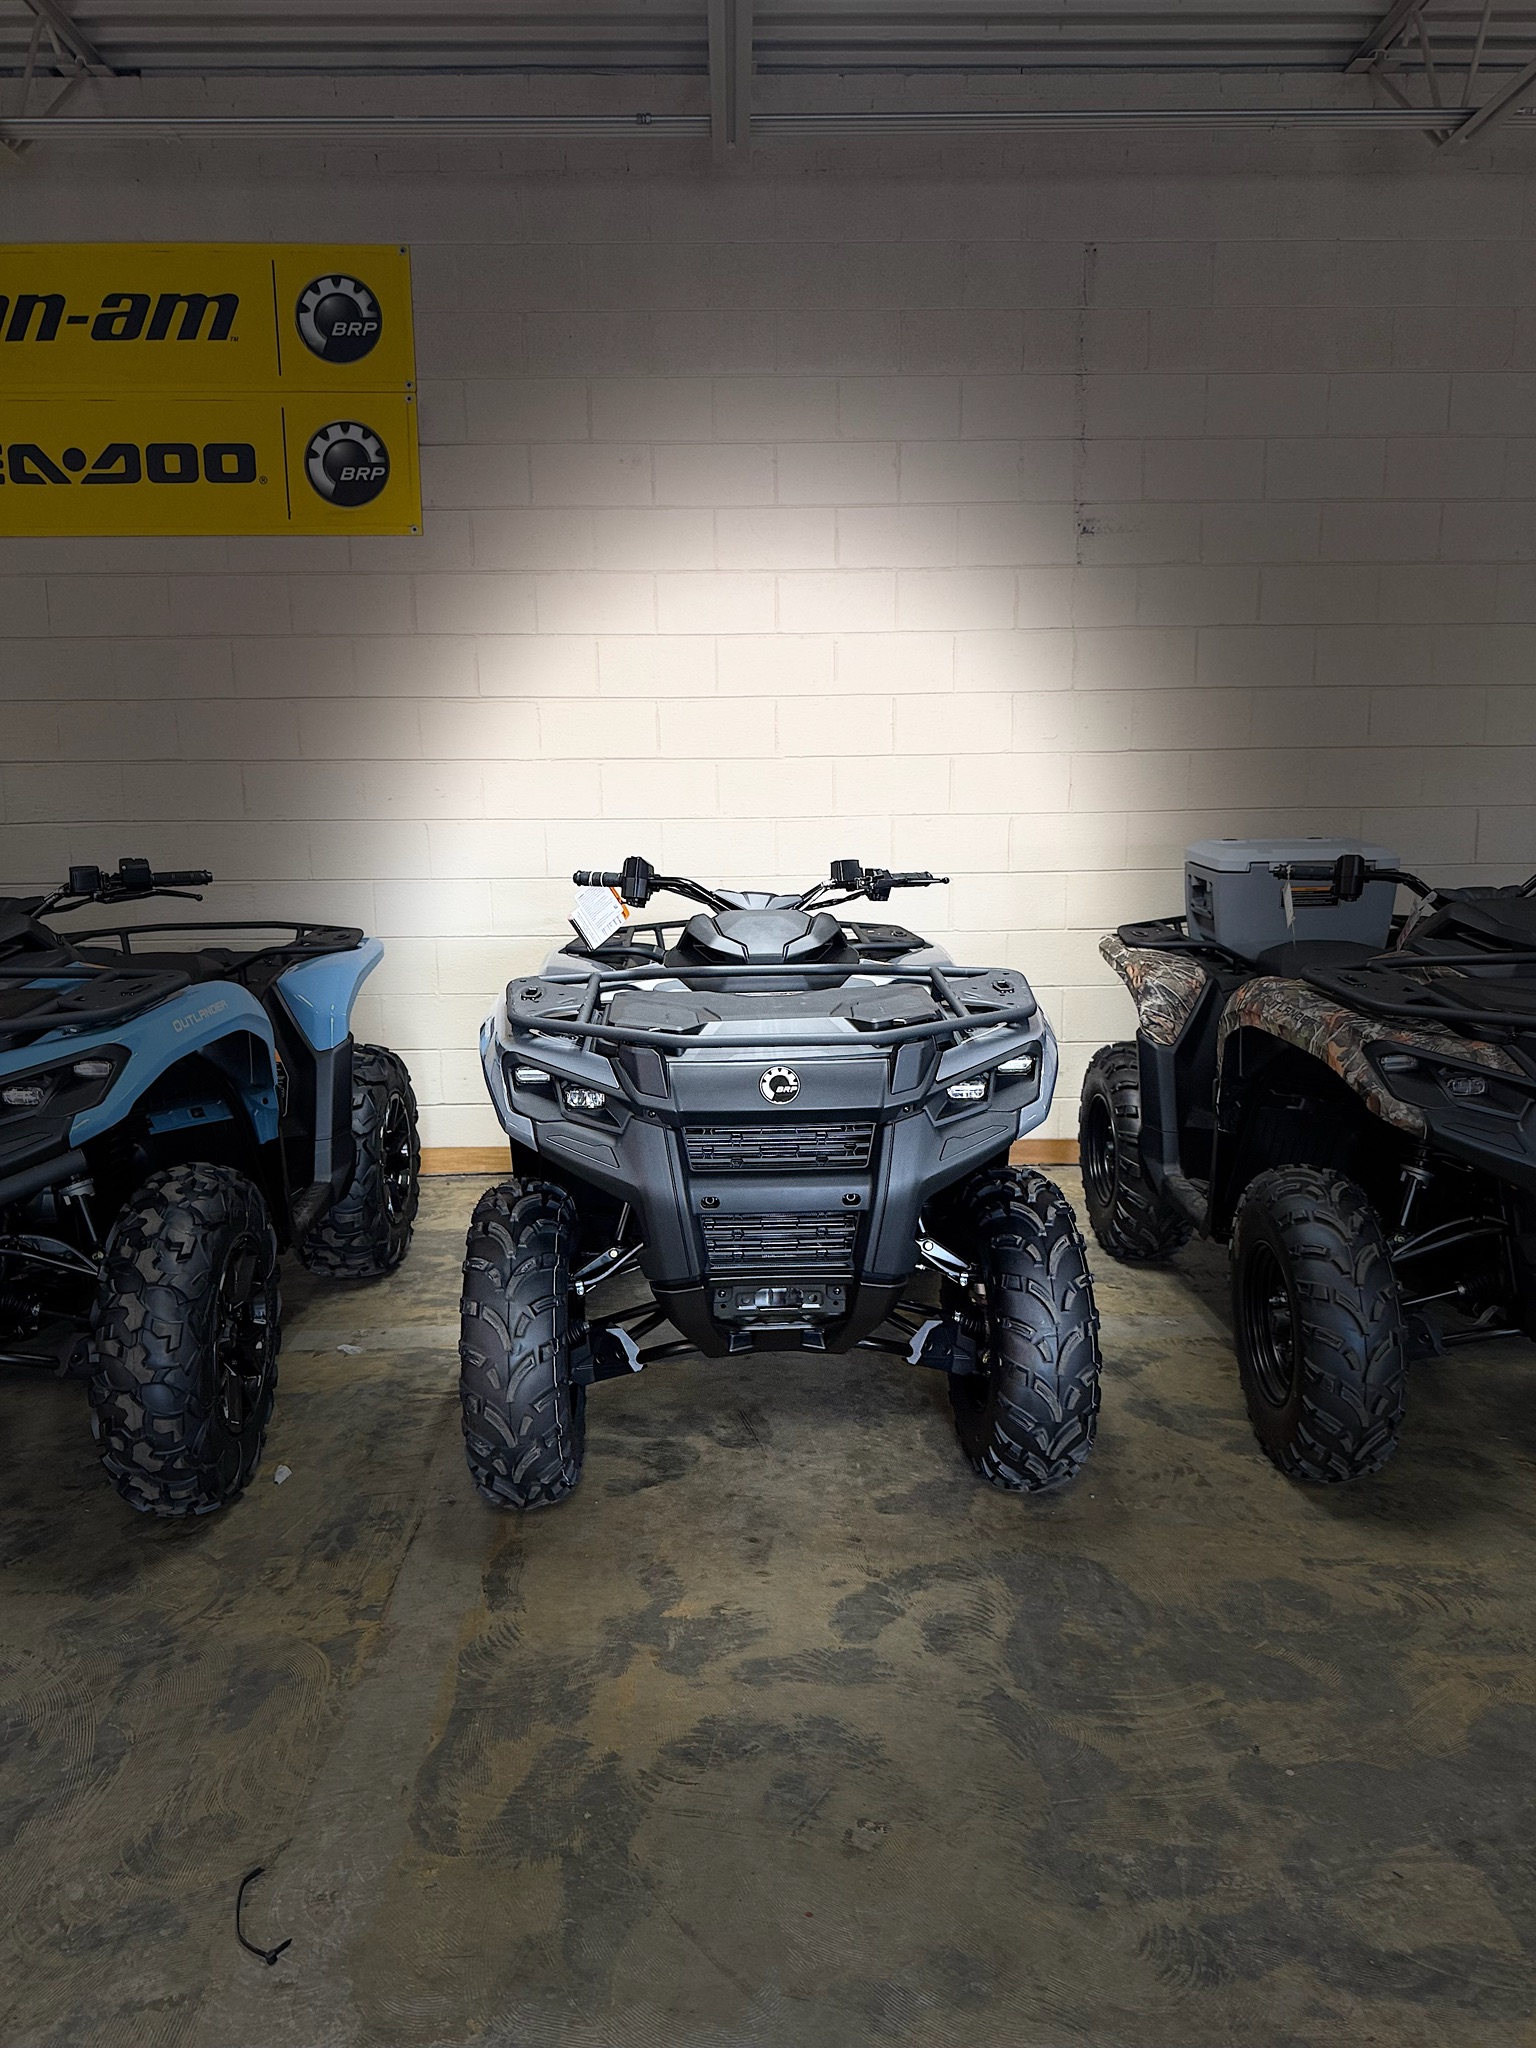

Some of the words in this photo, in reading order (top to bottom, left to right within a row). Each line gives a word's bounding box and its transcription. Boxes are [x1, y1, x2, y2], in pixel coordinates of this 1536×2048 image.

[0, 293, 239, 341] n-am
[331, 322, 378, 337] BRP
[340, 466, 386, 481] BRP
[172, 1000, 228, 1032] OUTLANDER
